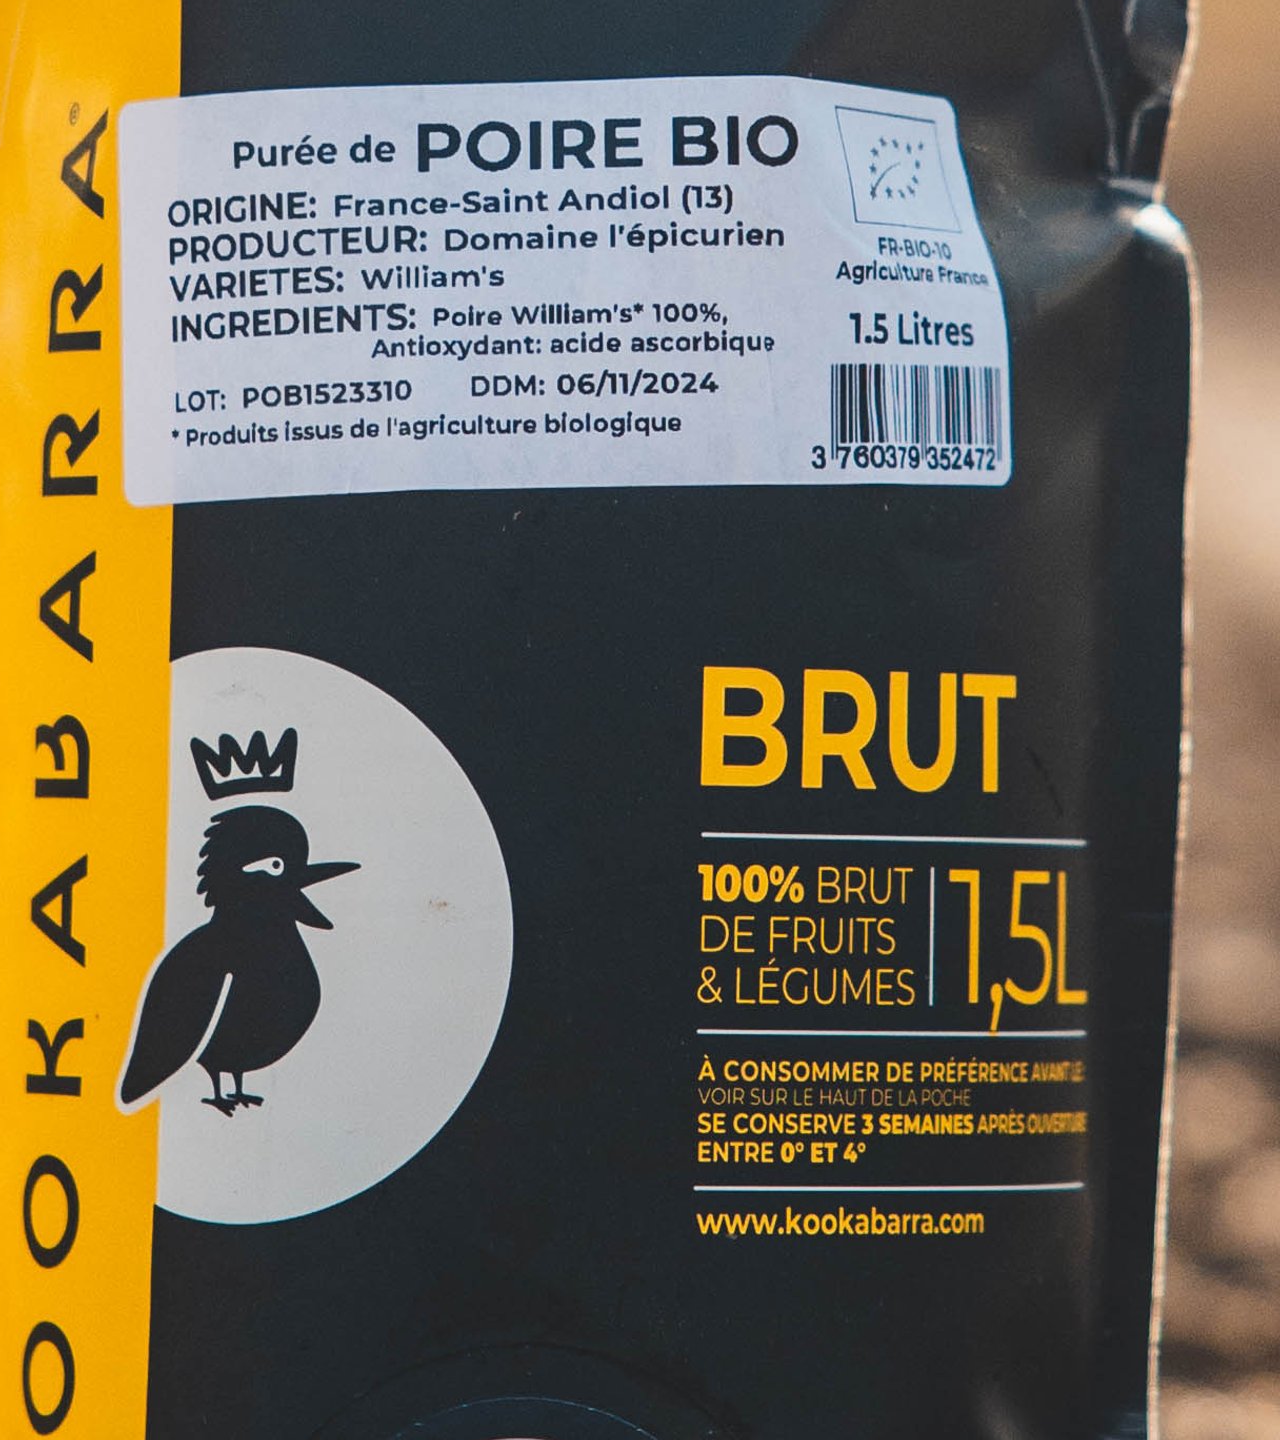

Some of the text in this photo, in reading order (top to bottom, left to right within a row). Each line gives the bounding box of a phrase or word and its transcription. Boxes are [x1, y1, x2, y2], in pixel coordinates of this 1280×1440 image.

[233, 115, 799, 172] Purée de POIRE BIO
[167, 184, 733, 227] ORIGINE: France-Saint Andiol (13)
[169, 222, 784, 265] PRODUCTEUR: Domaine l'épicurien
[878, 237, 952, 259] FR-BIO-10
[169, 265, 505, 302] VARIETES: William's
[836, 260, 988, 286] Agriculture France
[172, 303, 416, 342] INGREDIENTS:
[433, 305, 502, 327] Poire
[652, 303, 727, 326] 100%,
[849, 311, 974, 347] 1.5 Litres
[372, 331, 774, 360] Antioxydant: acide ascorbique
[175, 390, 226, 413] LOT:
[471, 375, 545, 397] DDM:
[557, 369, 719, 397] 06/11/2024
[186, 426, 278, 447] Produits
[285, 421, 343, 441] issus
[350, 418, 379, 438] de
[387, 414, 537, 440] l'agriculture
[545, 412, 681, 436] biologique
[700, 666, 1017, 793] BRUT
[698, 864, 913, 904] 100% BRUT
[701, 915, 895, 955] DE FRUITS
[949, 869, 1088, 1036] 1,5L
[697, 958, 915, 1006] & LÉGUMES
[698, 1054, 715, 1081] À
[723, 1060, 879, 1083] CONSOMMER
[886, 1062, 914, 1082] DE
[921, 1057, 1028, 1083] PRÉFÉRENCE
[698, 1088, 971, 1106] VOIR SUR LE HAUT DE LA POCHE
[697, 1113, 726, 1134] SE
[733, 1113, 856, 1134] CONSERVE
[862, 1114, 873, 1134] 3
[879, 1114, 974, 1134] SEMAINES
[978, 1109, 1025, 1134] APRÈS
[698, 1142, 773, 1163] ENTRE
[811, 1142, 838, 1163] ET
[697, 1206, 984, 1235] www.kookabarra.com
